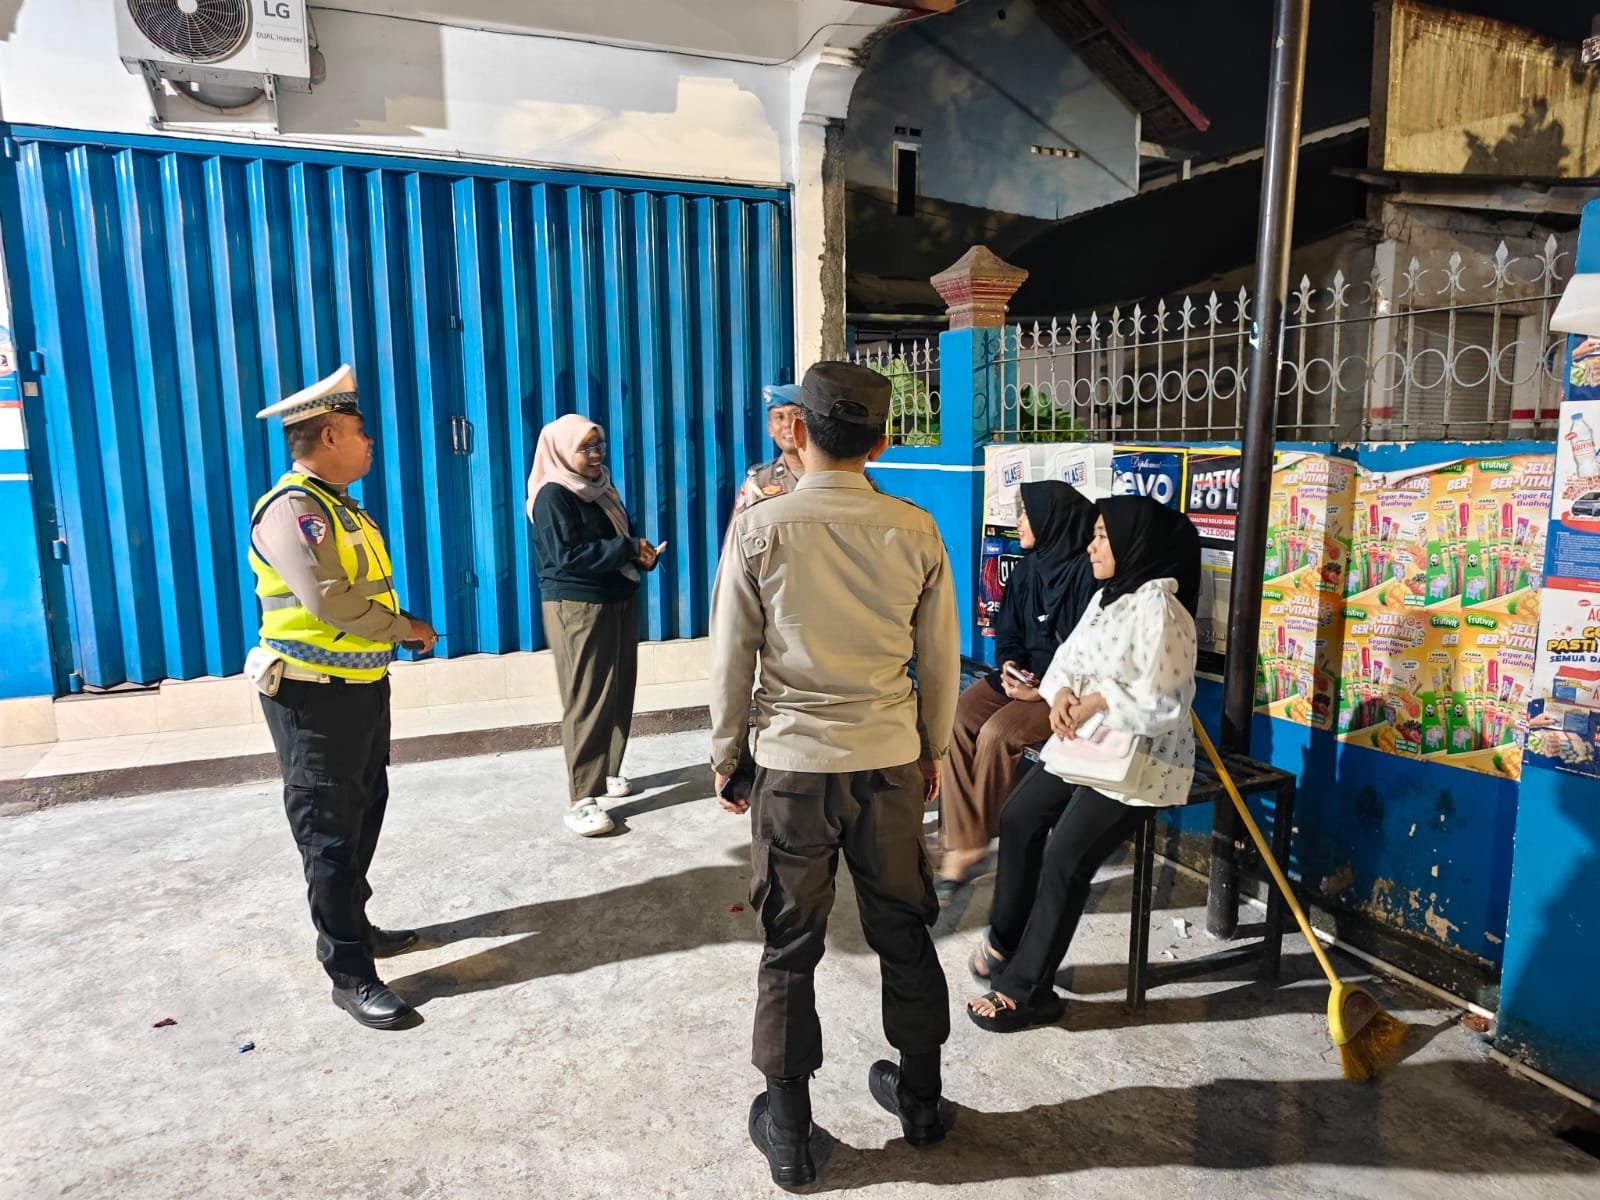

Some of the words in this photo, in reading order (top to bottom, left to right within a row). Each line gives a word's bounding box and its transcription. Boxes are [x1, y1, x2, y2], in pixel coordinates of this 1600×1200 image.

[264, 1, 290, 19] LG
[256, 32, 275, 40] DUAL
[1527, 462, 1552, 475] JELL
[1511, 492, 1537, 500] Segar
[1351, 623, 1418, 639] BER-VITAMIN
[1509, 623, 1537, 637] JELL
[1546, 639, 1598, 653] PASTI
[1496, 650, 1523, 659] Segar
